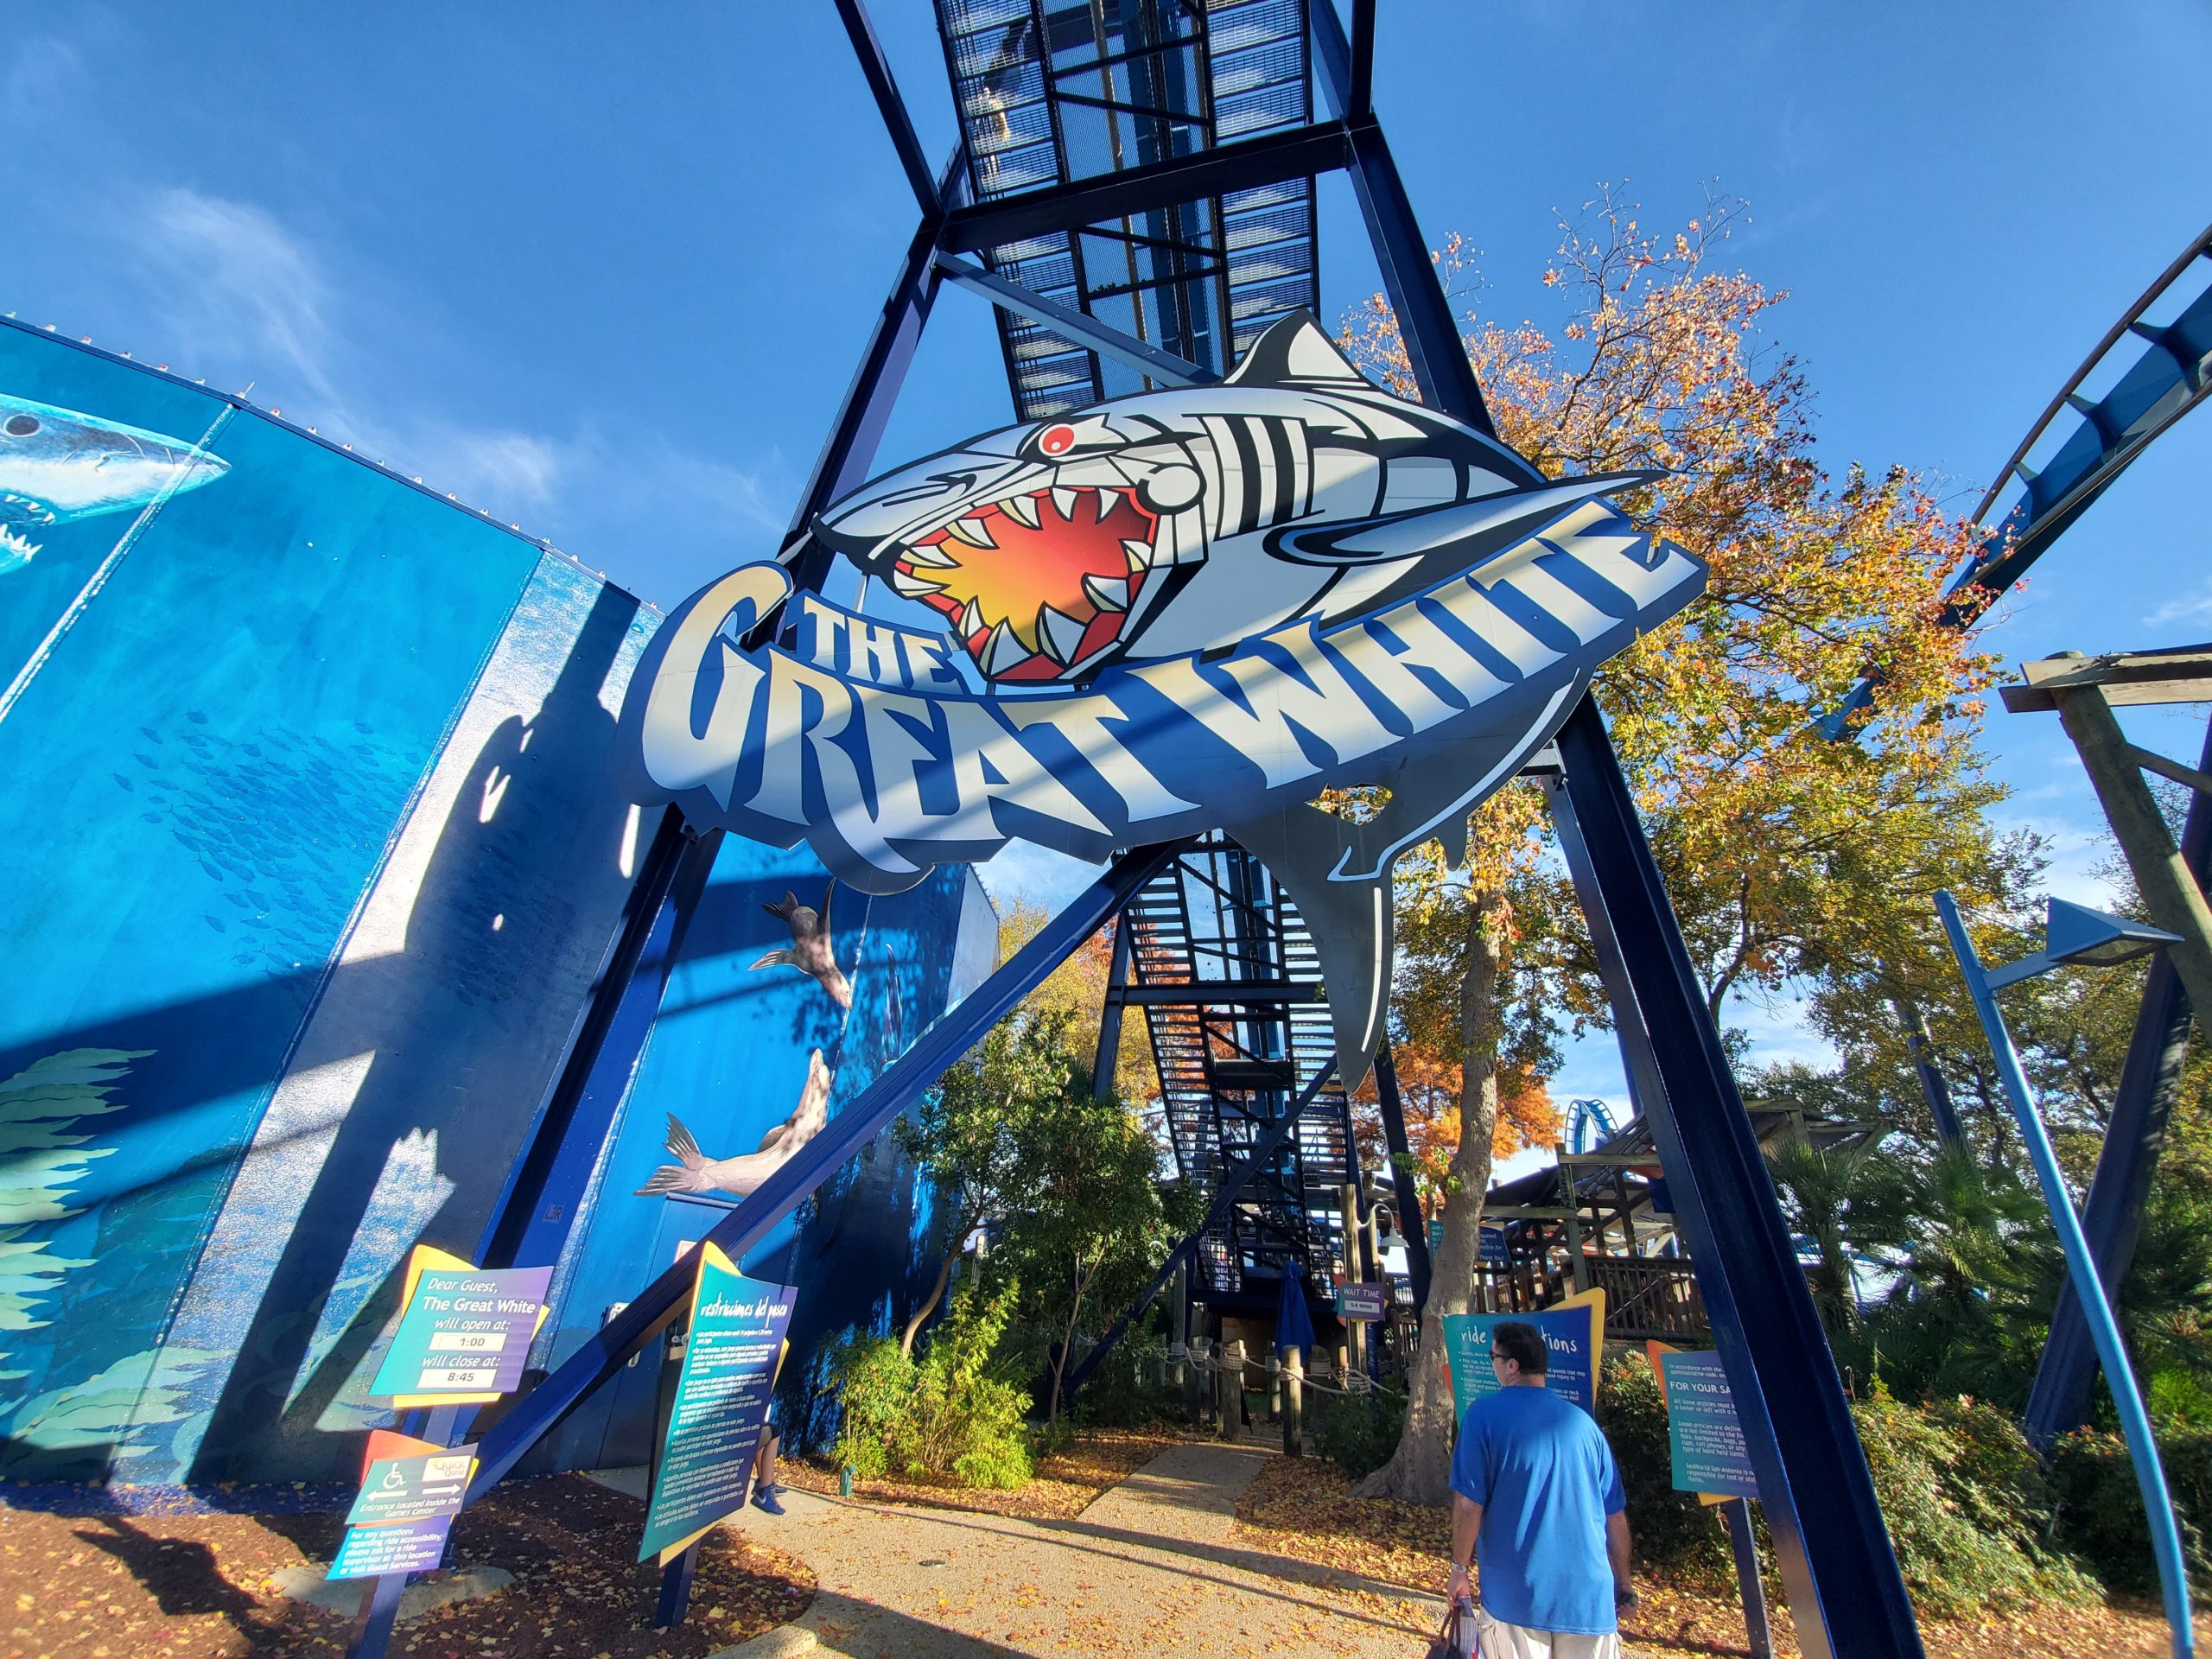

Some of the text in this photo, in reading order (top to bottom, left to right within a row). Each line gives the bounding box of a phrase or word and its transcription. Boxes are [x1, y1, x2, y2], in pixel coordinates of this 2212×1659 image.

[804, 597, 963, 695] THE
[642, 501, 1701, 874] GREAT WHITE
[427, 1278, 499, 1294] Dear Guest,
[1344, 1287, 1380, 1298] WAIT TIME
[422, 1296, 537, 1314] The Great White
[700, 1292, 788, 1329] restricciones del paseo
[435, 1318, 512, 1332] will open at:
[460, 1338, 485, 1347] 1:00
[1461, 1325, 1577, 1354] ride tions
[422, 1354, 501, 1367] will close at:
[448, 1372, 474, 1382] 8:45
[1669, 1382, 1731, 1394] FOR YOUR SA
[1726, 1472, 1737, 1481] lost
[360, 1497, 461, 1512] Entrance located inside the
[385, 1507, 436, 1517] Games Center
[379, 1528, 414, 1538] questions
[384, 1536, 399, 1545] ride
[400, 1534, 442, 1543] accessibility,
[385, 1545, 396, 1554] for
[407, 1551, 435, 1560] location
[367, 1563, 389, 1572] Guest
[390, 1560, 421, 1571] Services.
